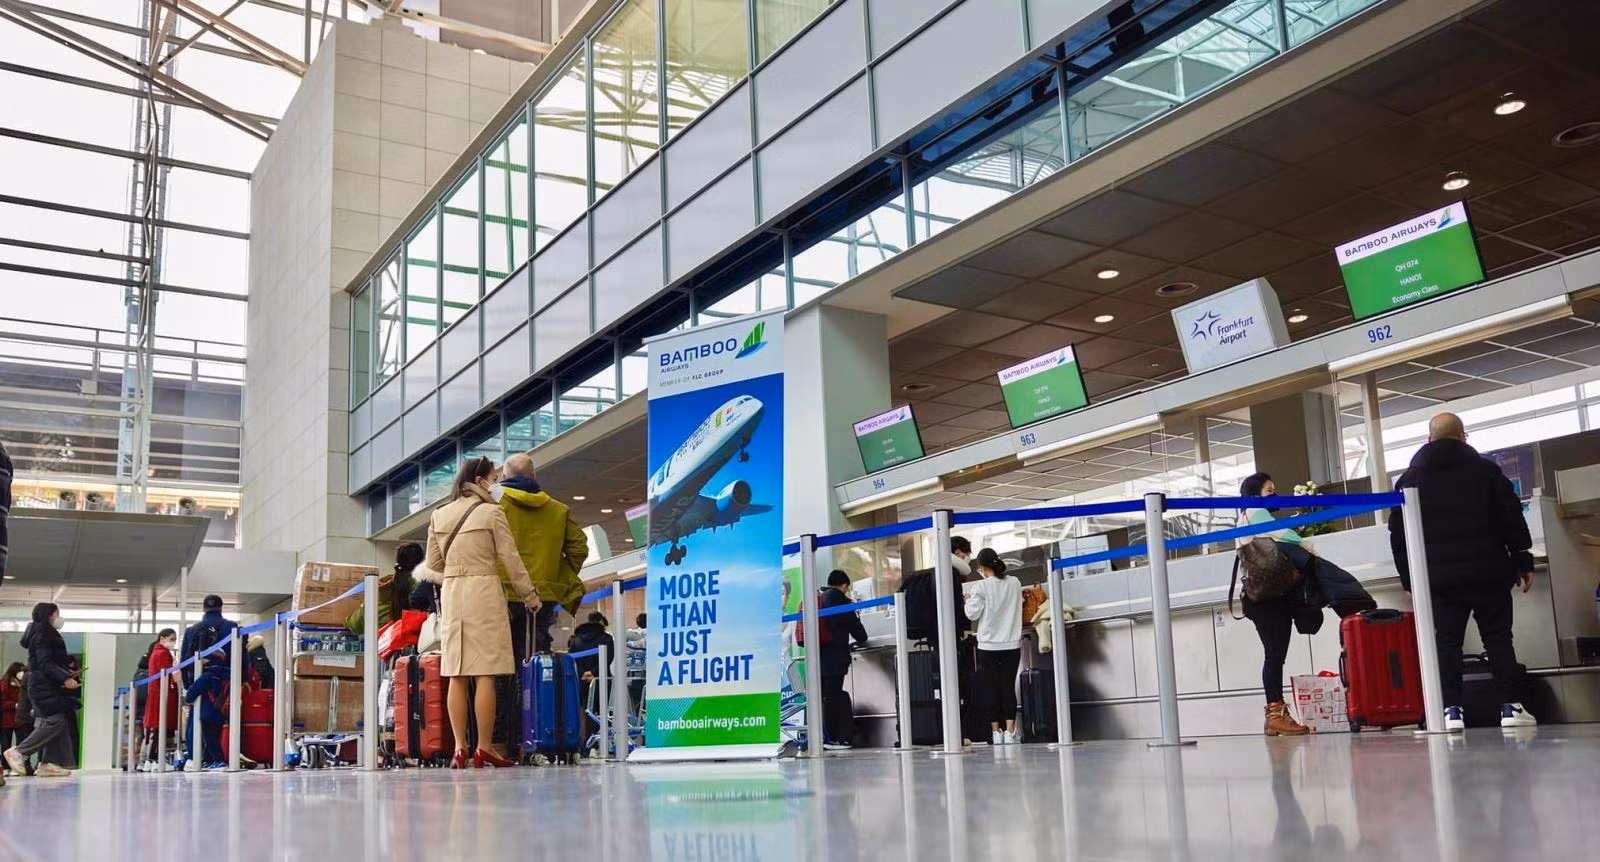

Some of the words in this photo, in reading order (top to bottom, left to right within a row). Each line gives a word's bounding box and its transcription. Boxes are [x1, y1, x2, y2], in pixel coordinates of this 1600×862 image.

[1345, 236, 1388, 256] BAMBOO
[1391, 219, 1436, 240] AIRWAYS
[1395, 264, 1406, 273] QH
[1406, 259, 1419, 269] 074
[1400, 273, 1422, 286] HANOI
[1392, 291, 1421, 304] Economy
[1421, 284, 1438, 294] Class
[1217, 316, 1254, 337] Frankfurt
[1368, 325, 1392, 343] 962
[1219, 331, 1247, 346] Airport
[660, 338, 737, 366] BAMBOO
[660, 363, 689, 374] AIRWAYS
[1030, 356, 1057, 370] AIRWAYS
[704, 369, 724, 378] GROUP
[1020, 433, 1036, 446] 963
[873, 478, 886, 490] 964
[660, 569, 720, 600] MORE
[658, 599, 717, 629] THAN
[657, 628, 712, 658] JUST
[657, 660, 673, 686] A
[678, 654, 753, 684] FLIGHT
[657, 716, 766, 731] bambooairways.com
